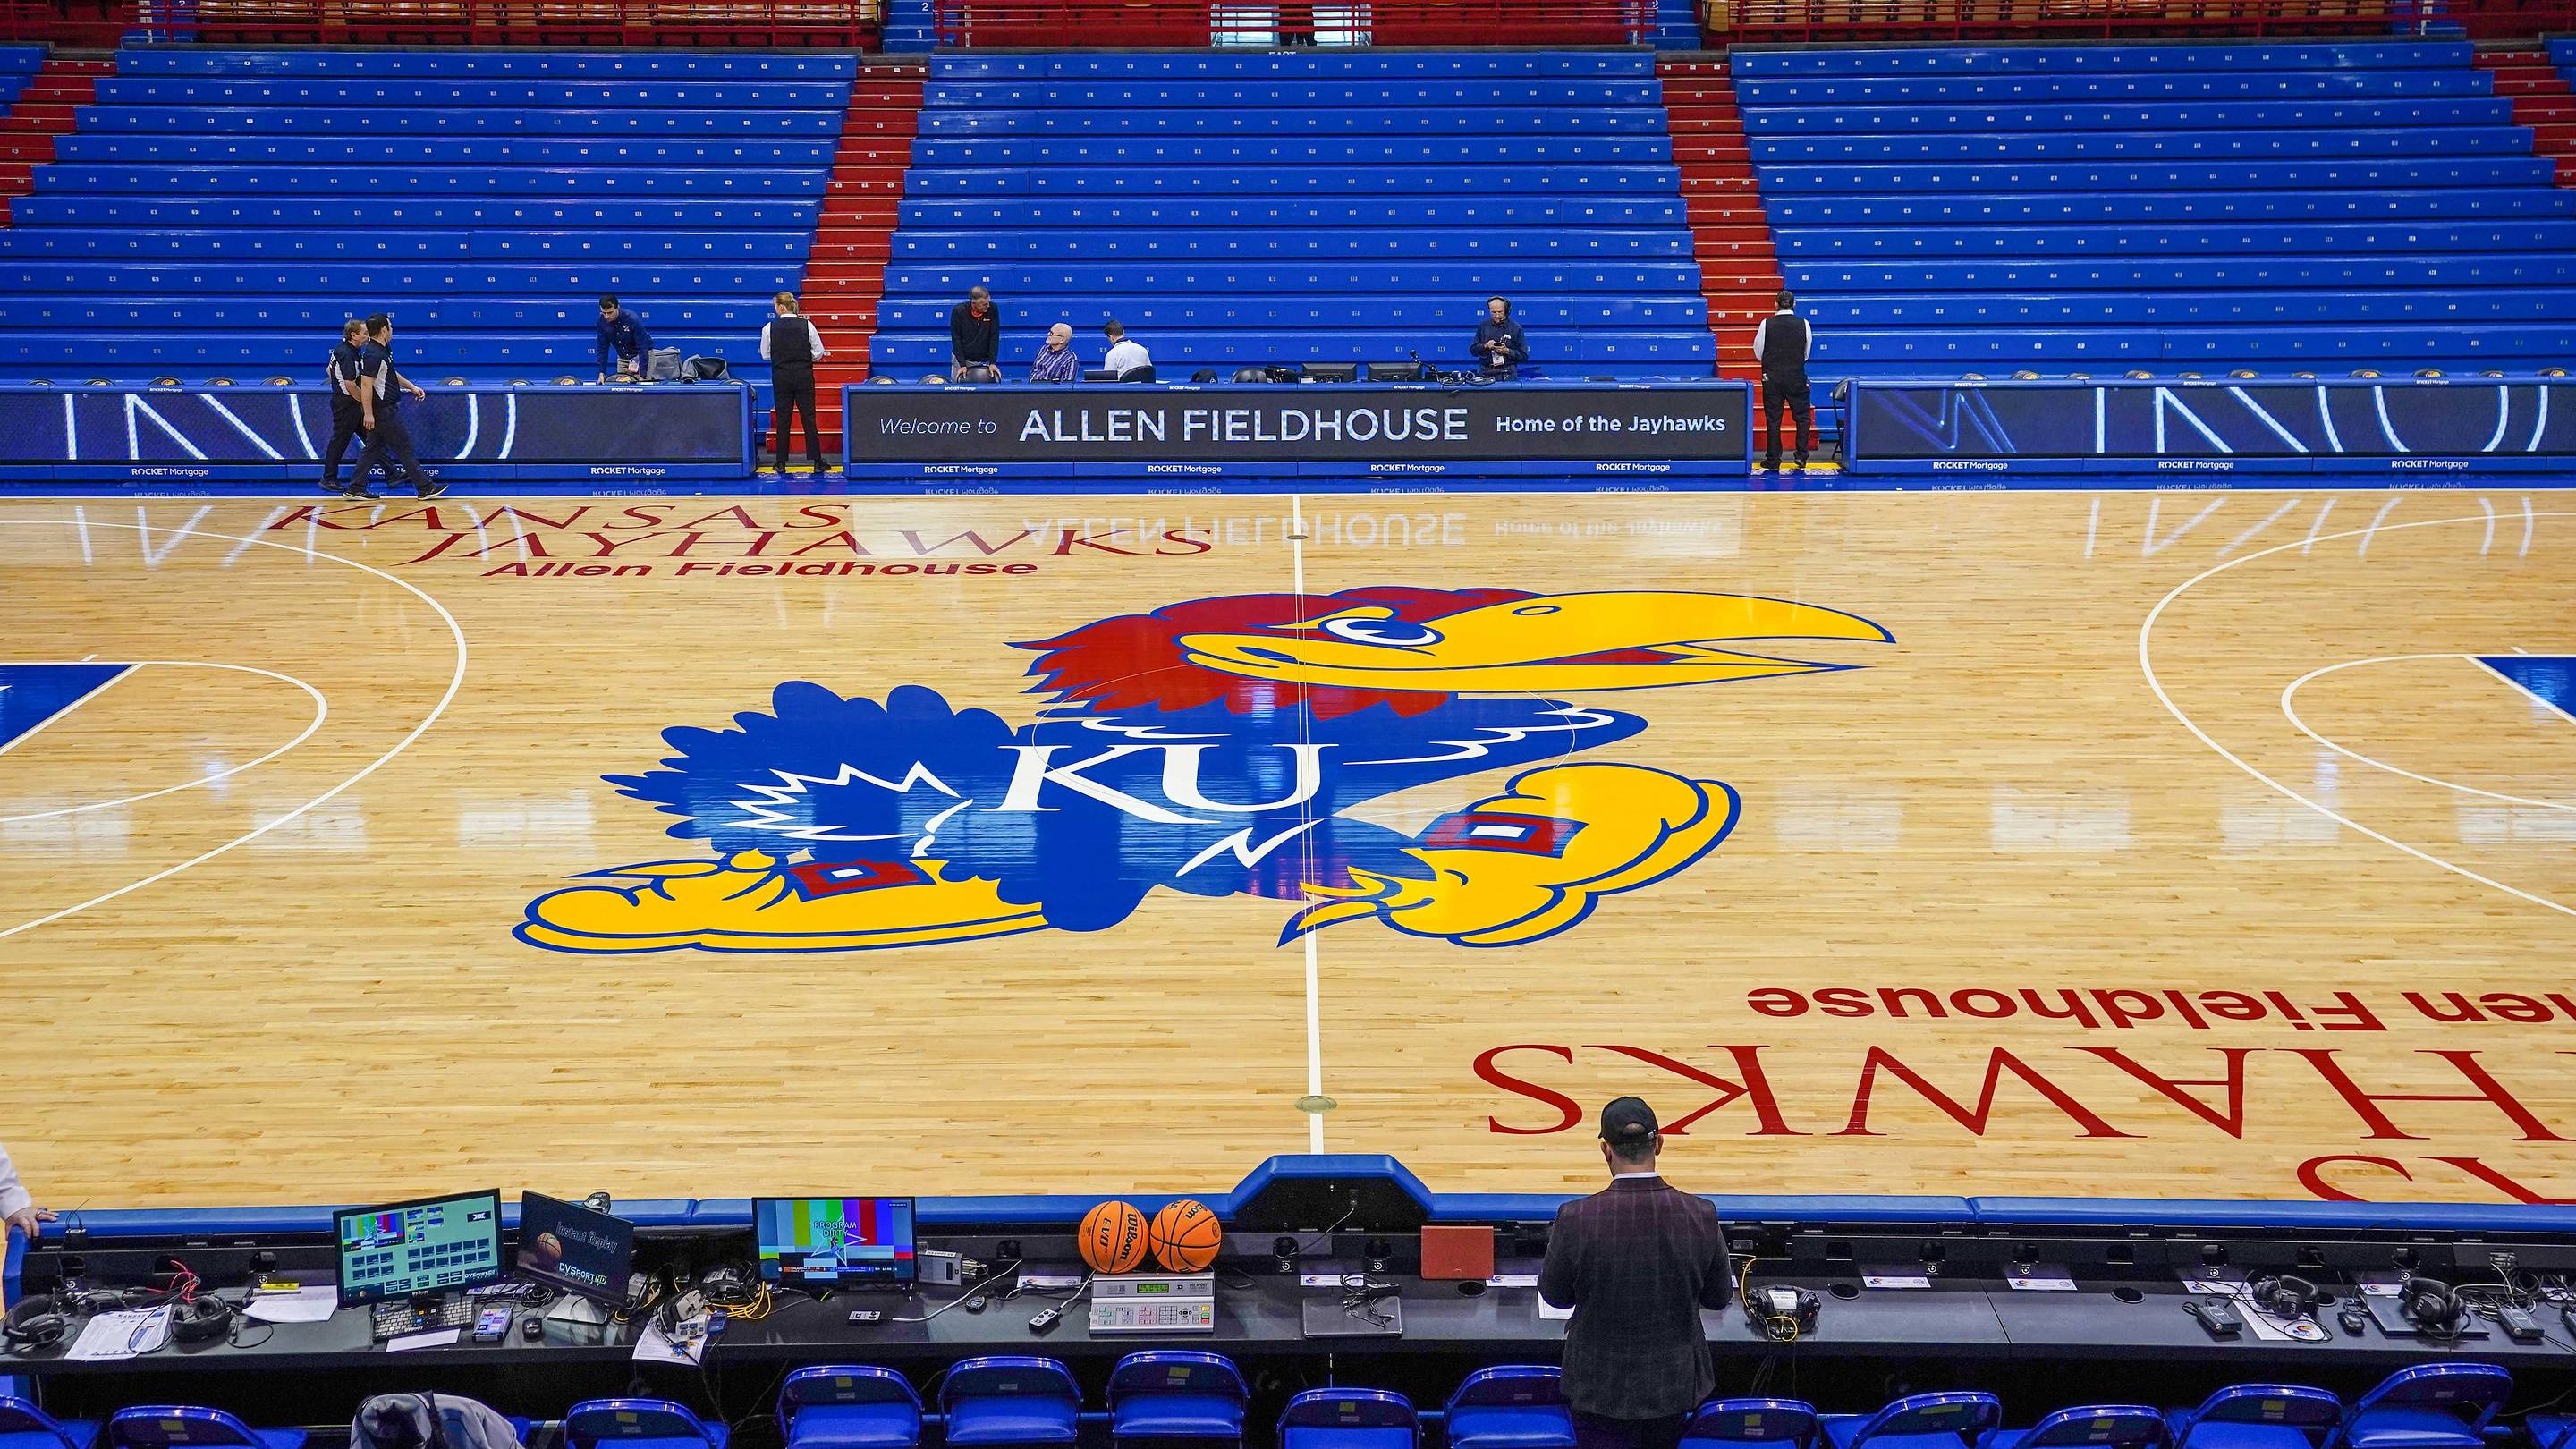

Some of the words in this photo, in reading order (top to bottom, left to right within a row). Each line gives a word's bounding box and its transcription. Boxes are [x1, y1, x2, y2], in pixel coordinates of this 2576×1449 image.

[921, 2, 928, 12] 2
[917, 29, 922, 38] 1
[1660, 27, 1666, 36] 1
[880, 417, 970, 435] Welcome
[977, 419, 996, 435] to
[1019, 409, 1165, 442] ALLEN
[1183, 408, 1468, 442] FIELDHOUSE
[1496, 416, 1555, 432] Home
[1562, 415, 1583, 432] of
[1588, 415, 1622, 432] the
[1627, 414, 1726, 436] Jayhawks
[924, 465, 960, 473] ROCKET
[960, 465, 998, 475] Mortgage
[1148, 464, 1183, 472] ROCKET
[1183, 464, 1222, 474] Mortgage
[1370, 463, 1406, 471] ROCKET
[1407, 463, 1445, 473] Mortgage
[1596, 463, 1631, 471] ROCKET
[1632, 463, 1670, 472] Mortgage
[1933, 462, 1969, 470] ROCKET
[1970, 462, 2008, 470] Mortgage
[2158, 461, 2194, 469] ROCKET
[2195, 461, 2234, 470] Mortgage
[2391, 460, 2428, 468] ROCKET
[2429, 460, 2469, 470] Mortgage
[132, 468, 168, 476] ROCKET
[169, 468, 209, 477] Mortgage
[590, 467, 626, 475] ROCKET
[627, 467, 665, 476] Mortgage
[267, 505, 852, 530] KANSAS
[390, 530, 1212, 566] JAYHAWKS
[480, 562, 653, 578] Allen
[676, 562, 1038, 578] Fieldhouse
[980, 744, 1339, 824] KU
[1749, 987, 2389, 1031] Fieldhouse
[1473, 1043, 2576, 1142] HAWKS
[813, 1221, 857, 1230] PROGRAM
[555, 1221, 587, 1243] Instant
[587, 1231, 618, 1253] Replay
[822, 1229, 849, 1238] DIRTY
[1120, 1213, 1139, 1260] Wilson
